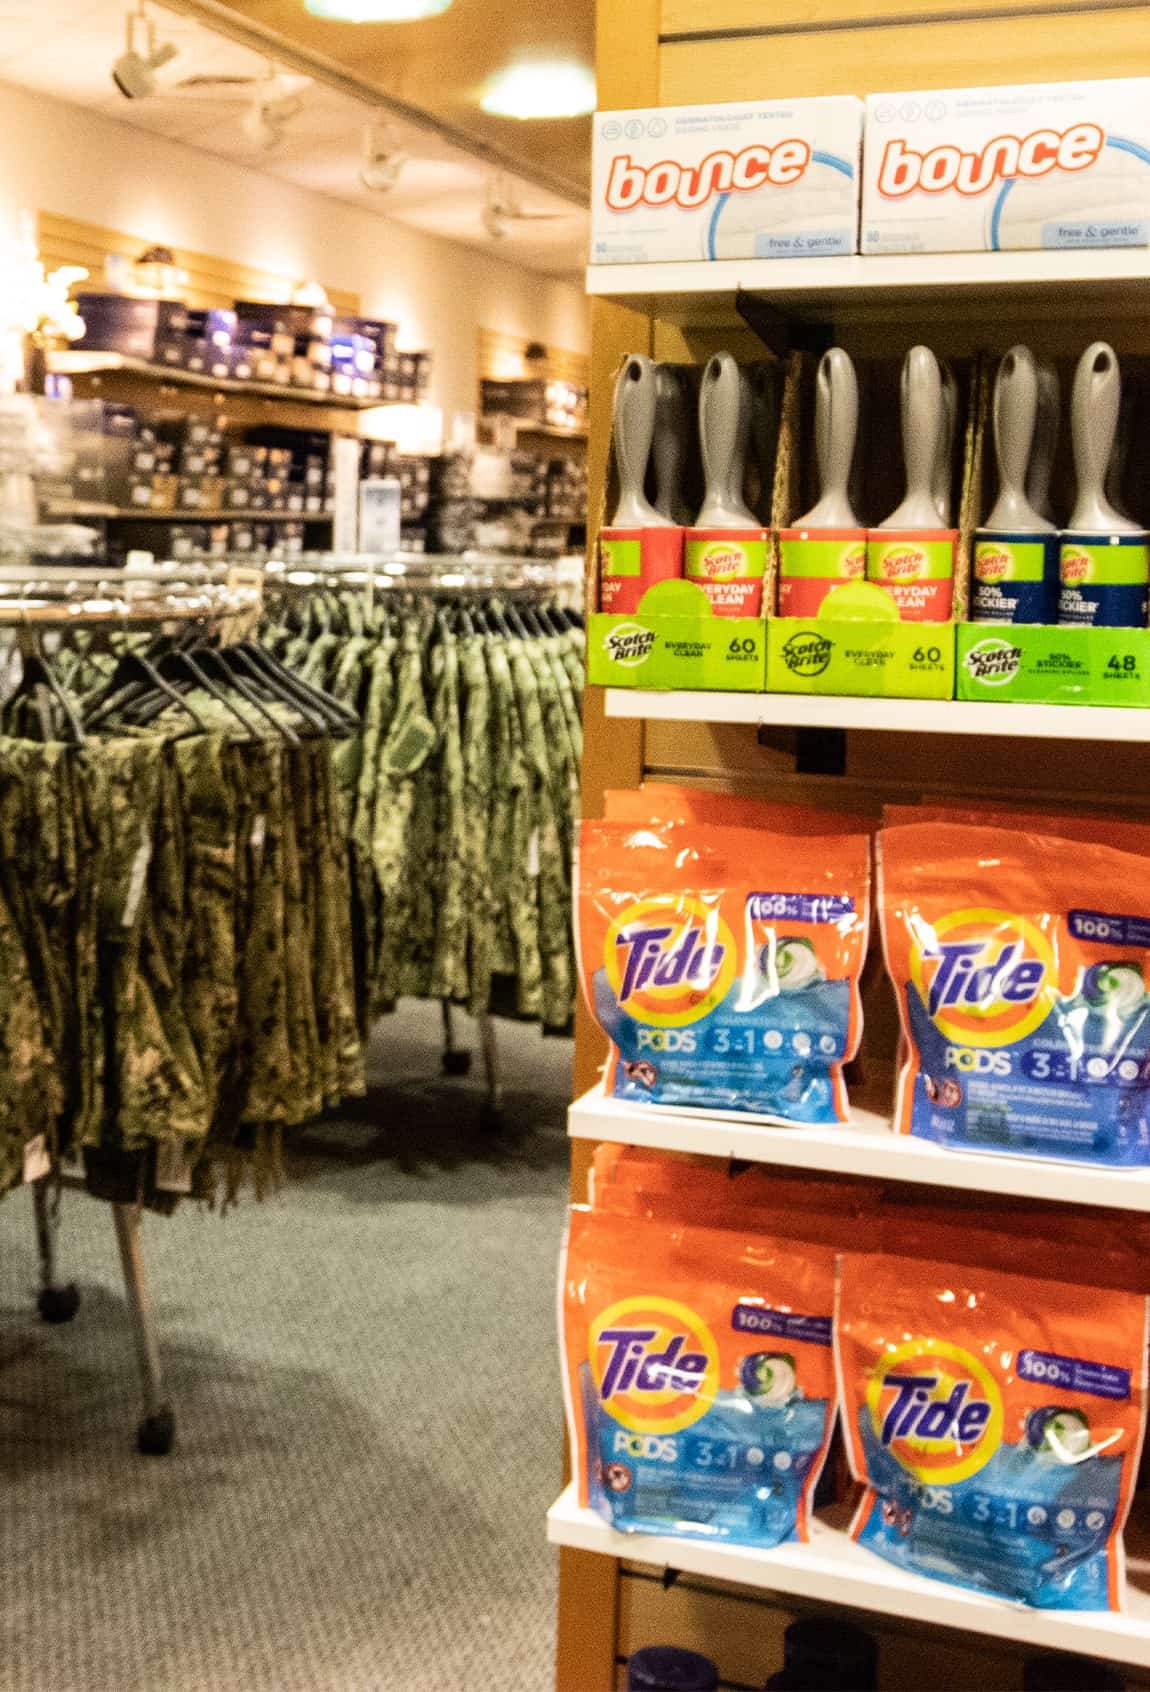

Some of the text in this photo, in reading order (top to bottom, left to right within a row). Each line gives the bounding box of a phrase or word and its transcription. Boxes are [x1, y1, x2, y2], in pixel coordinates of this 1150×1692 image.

[877, 122, 1105, 197] bounce
[605, 138, 811, 211] bounce
[1058, 224, 1139, 238] free & gentle
[769, 236, 842, 249] free & gentle
[711, 594, 745, 605] LEAN
[896, 597, 926, 608] EAN
[608, 631, 656, 648] Scotch
[664, 641, 711, 649] EVERYDAY
[728, 638, 755, 653] 60
[782, 640, 833, 656] Scotch
[614, 644, 653, 661] Brite
[673, 649, 703, 657] CLEAN
[788, 653, 829, 669] Brite
[844, 650, 895, 659] EVERYDAY
[913, 647, 941, 663] 60
[968, 648, 1022, 666] Scotch
[854, 658, 886, 666] CLEAN
[974, 660, 1020, 677] Brite
[1107, 655, 1137, 671] 48
[1074, 918, 1122, 939] 100%
[615, 927, 725, 1003] Tide
[922, 943, 1045, 1018] Tide
[637, 1029, 697, 1052] PODS
[946, 1047, 1012, 1076] PODS
[598, 1330, 709, 1400] Tide
[1023, 1357, 1071, 1383] 100%
[882, 1375, 992, 1446] Tide
[613, 1431, 678, 1463] PODS
